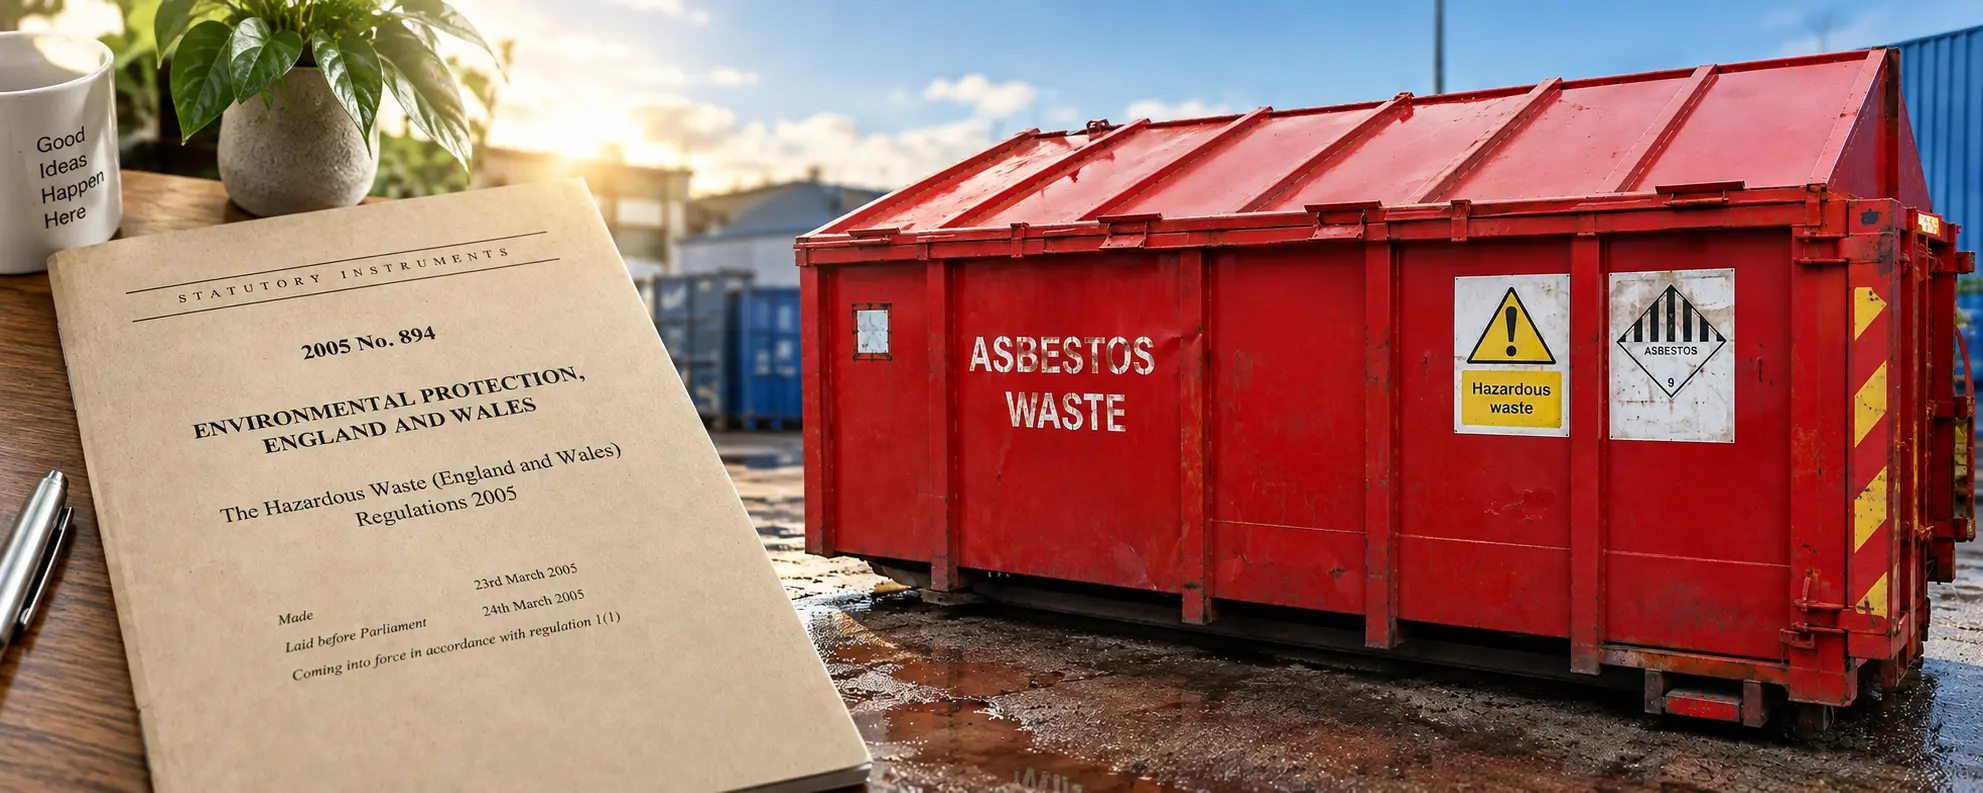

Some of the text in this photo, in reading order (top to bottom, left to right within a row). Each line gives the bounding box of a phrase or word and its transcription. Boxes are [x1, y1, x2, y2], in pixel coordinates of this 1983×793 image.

[37, 126, 85, 153] Good
[40, 155, 87, 178] Ideas
[42, 171, 104, 204] Happen
[45, 206, 86, 229] Here
[179, 248, 509, 303] STATUTORY INSTRUMENTS
[301, 326, 436, 360] 2005 No. 894
[969, 336, 1154, 375] ASBESTOS
[1644, 346, 1697, 355] ASBESTOS
[1472, 382, 1550, 396] Hazardous
[1668, 378, 1674, 387] 9
[193, 366, 585, 440] ENVIRONMENTAL PROTECTION,
[1005, 391, 1126, 432] WASTE
[1490, 402, 1533, 414] waste
[262, 397, 537, 453] ENGLAND AND WALES
[220, 442, 621, 524] The Hazardous Waste (England and Wales)
[355, 485, 517, 528] Regulations 2005
[278, 563, 578, 625] Made 23rd March 2005
[285, 589, 585, 653] Laid before Parliament 24th March 2005
[292, 611, 621, 681] Coming into force in accordance with regulation 1(1)
